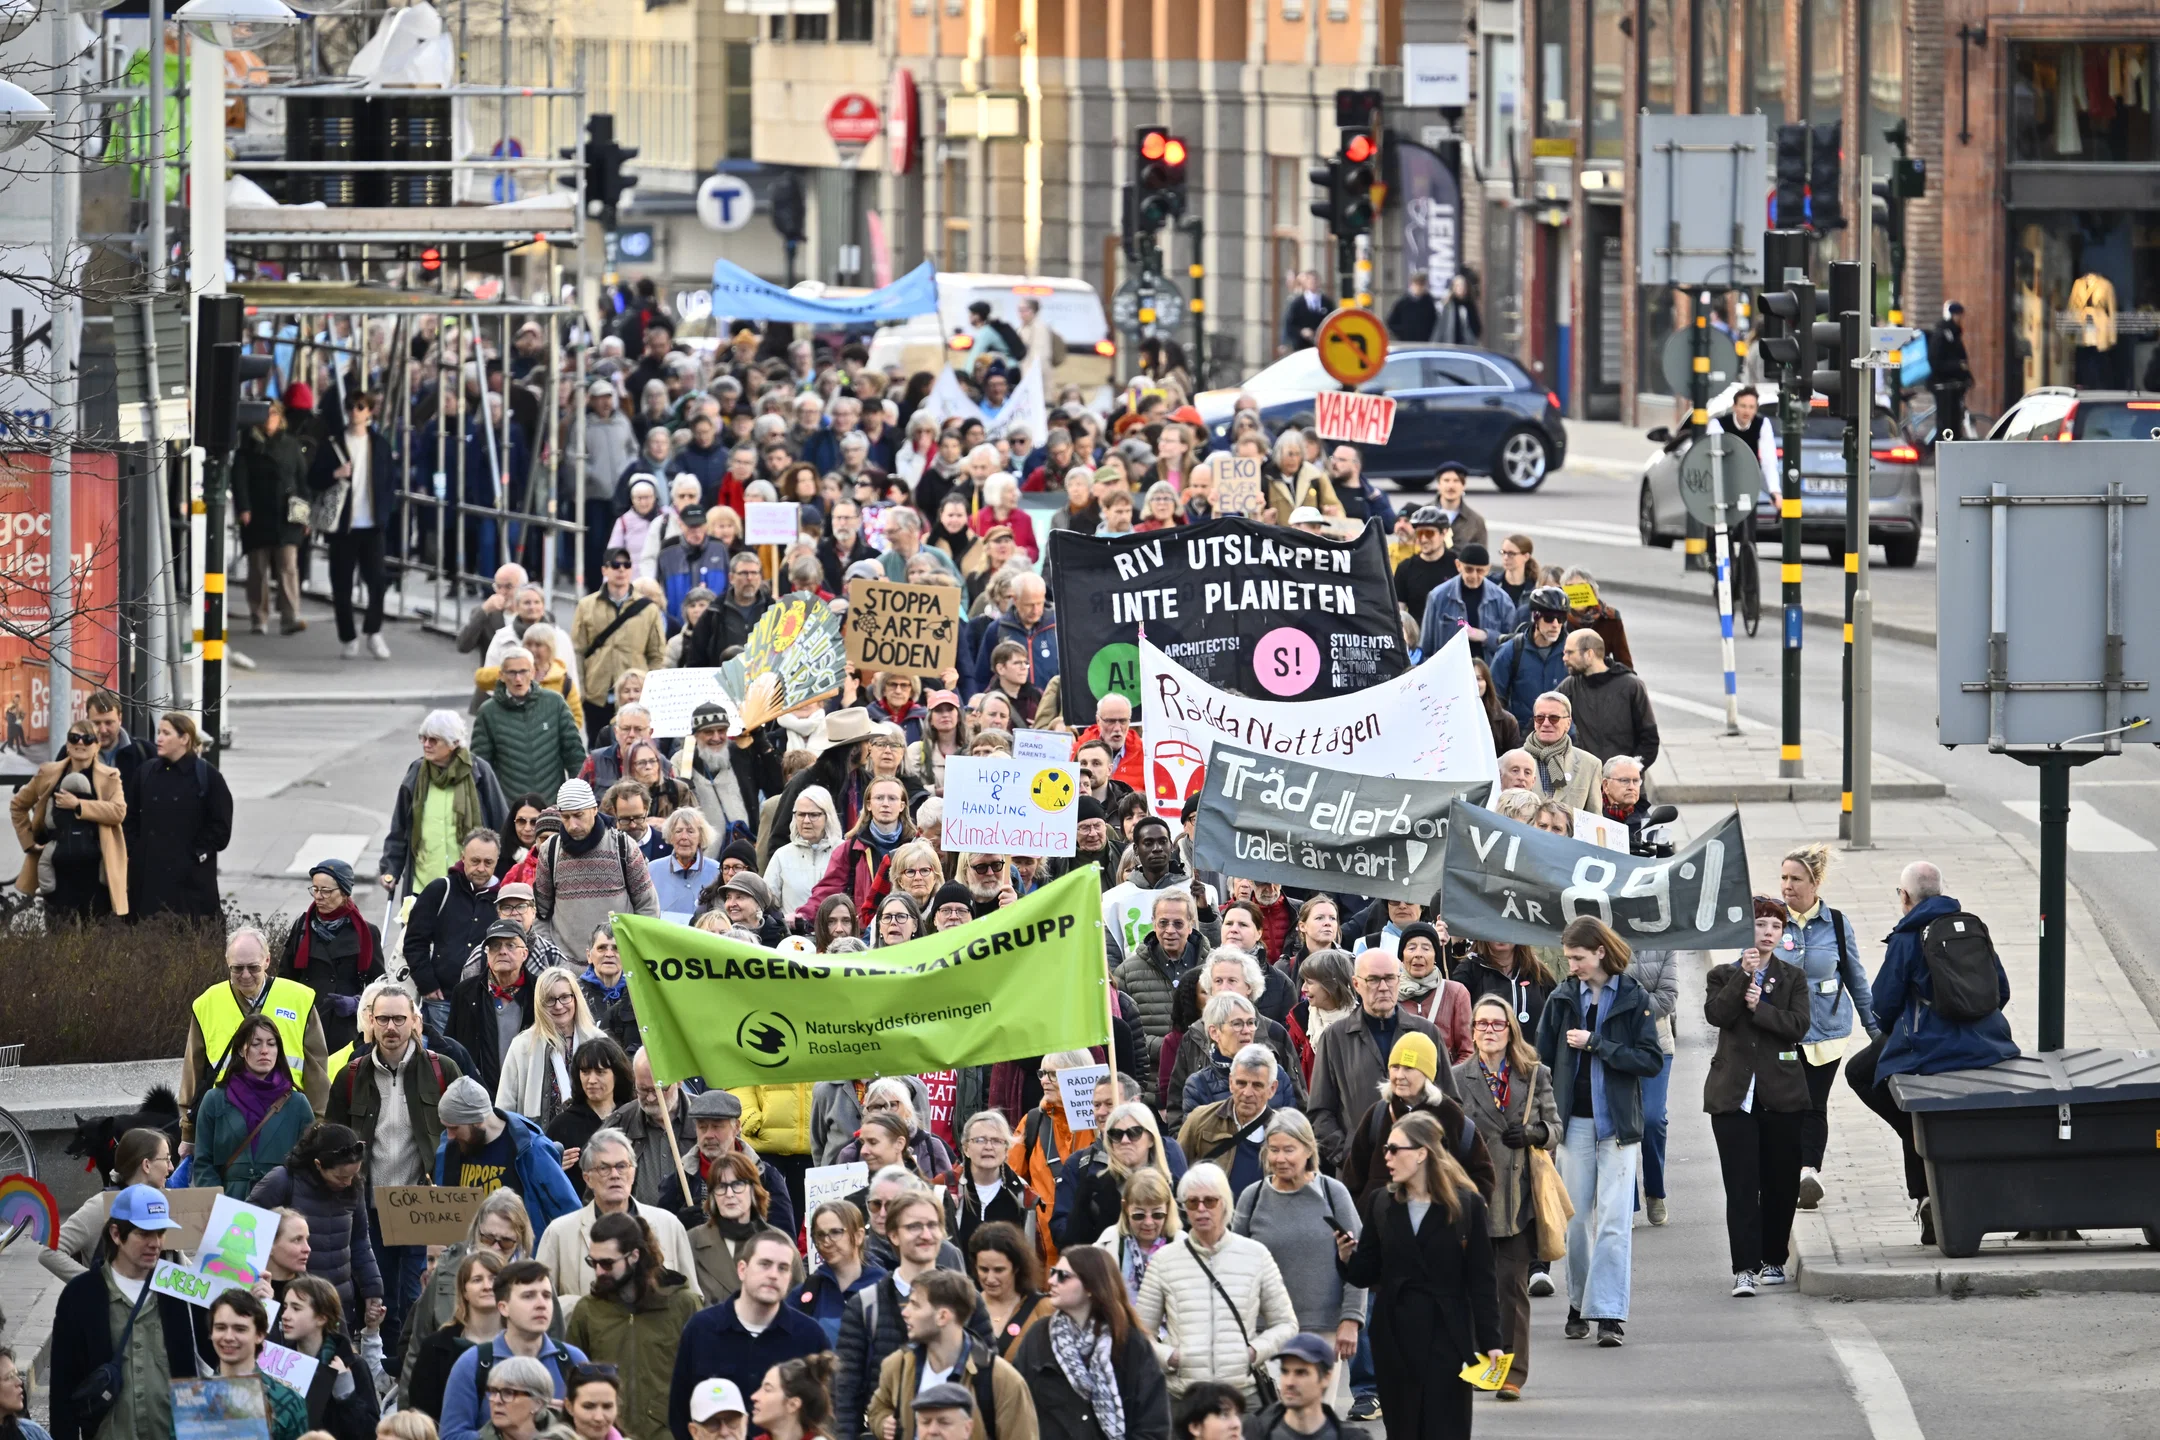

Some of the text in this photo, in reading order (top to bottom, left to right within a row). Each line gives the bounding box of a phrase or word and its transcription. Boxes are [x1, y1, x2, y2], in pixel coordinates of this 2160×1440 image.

[711, 189, 741, 222] T
[1317, 392, 1395, 443] VAKNA!
[1220, 459, 1256, 479] EKO
[1113, 539, 1164, 582] RIV
[864, 587, 941, 615] STOPPA
[1112, 579, 1356, 623] INTE PLANETEN
[1163, 637, 1240, 658] ARCHITECTS!
[1330, 633, 1395, 649] STUDENTS!
[862, 637, 940, 669] DÖDEN
[1274, 647, 1301, 677] S!
[1331, 647, 1381, 661] CLIMATE
[1107, 659, 1134, 692] A!
[1332, 660, 1377, 674] ACTION
[1018, 751, 1047, 759] PARENTS
[1019, 742, 1044, 750] GRAND
[978, 768, 1021, 784] HOPP
[991, 783, 1003, 801] &
[1216, 750, 1319, 813] Träd
[1309, 790, 1396, 837] eller
[961, 800, 1027, 818] HANDLING
[1300, 840, 1331, 870] är
[1469, 824, 1522, 872] VI
[1501, 889, 1550, 925] ÄR
[644, 957, 831, 982] ROSLAGENS
[276, 1009, 296, 1020] PRO
[805, 1001, 992, 1036] Naturskyddsföreningen
[808, 1040, 881, 1055] Roslagen
[388, 1188, 480, 1208] GÖR FLYGET
[809, 1179, 849, 1198] ENLIGT
[409, 1210, 463, 1225] DYRARE
[155, 1265, 211, 1300] GREEN
